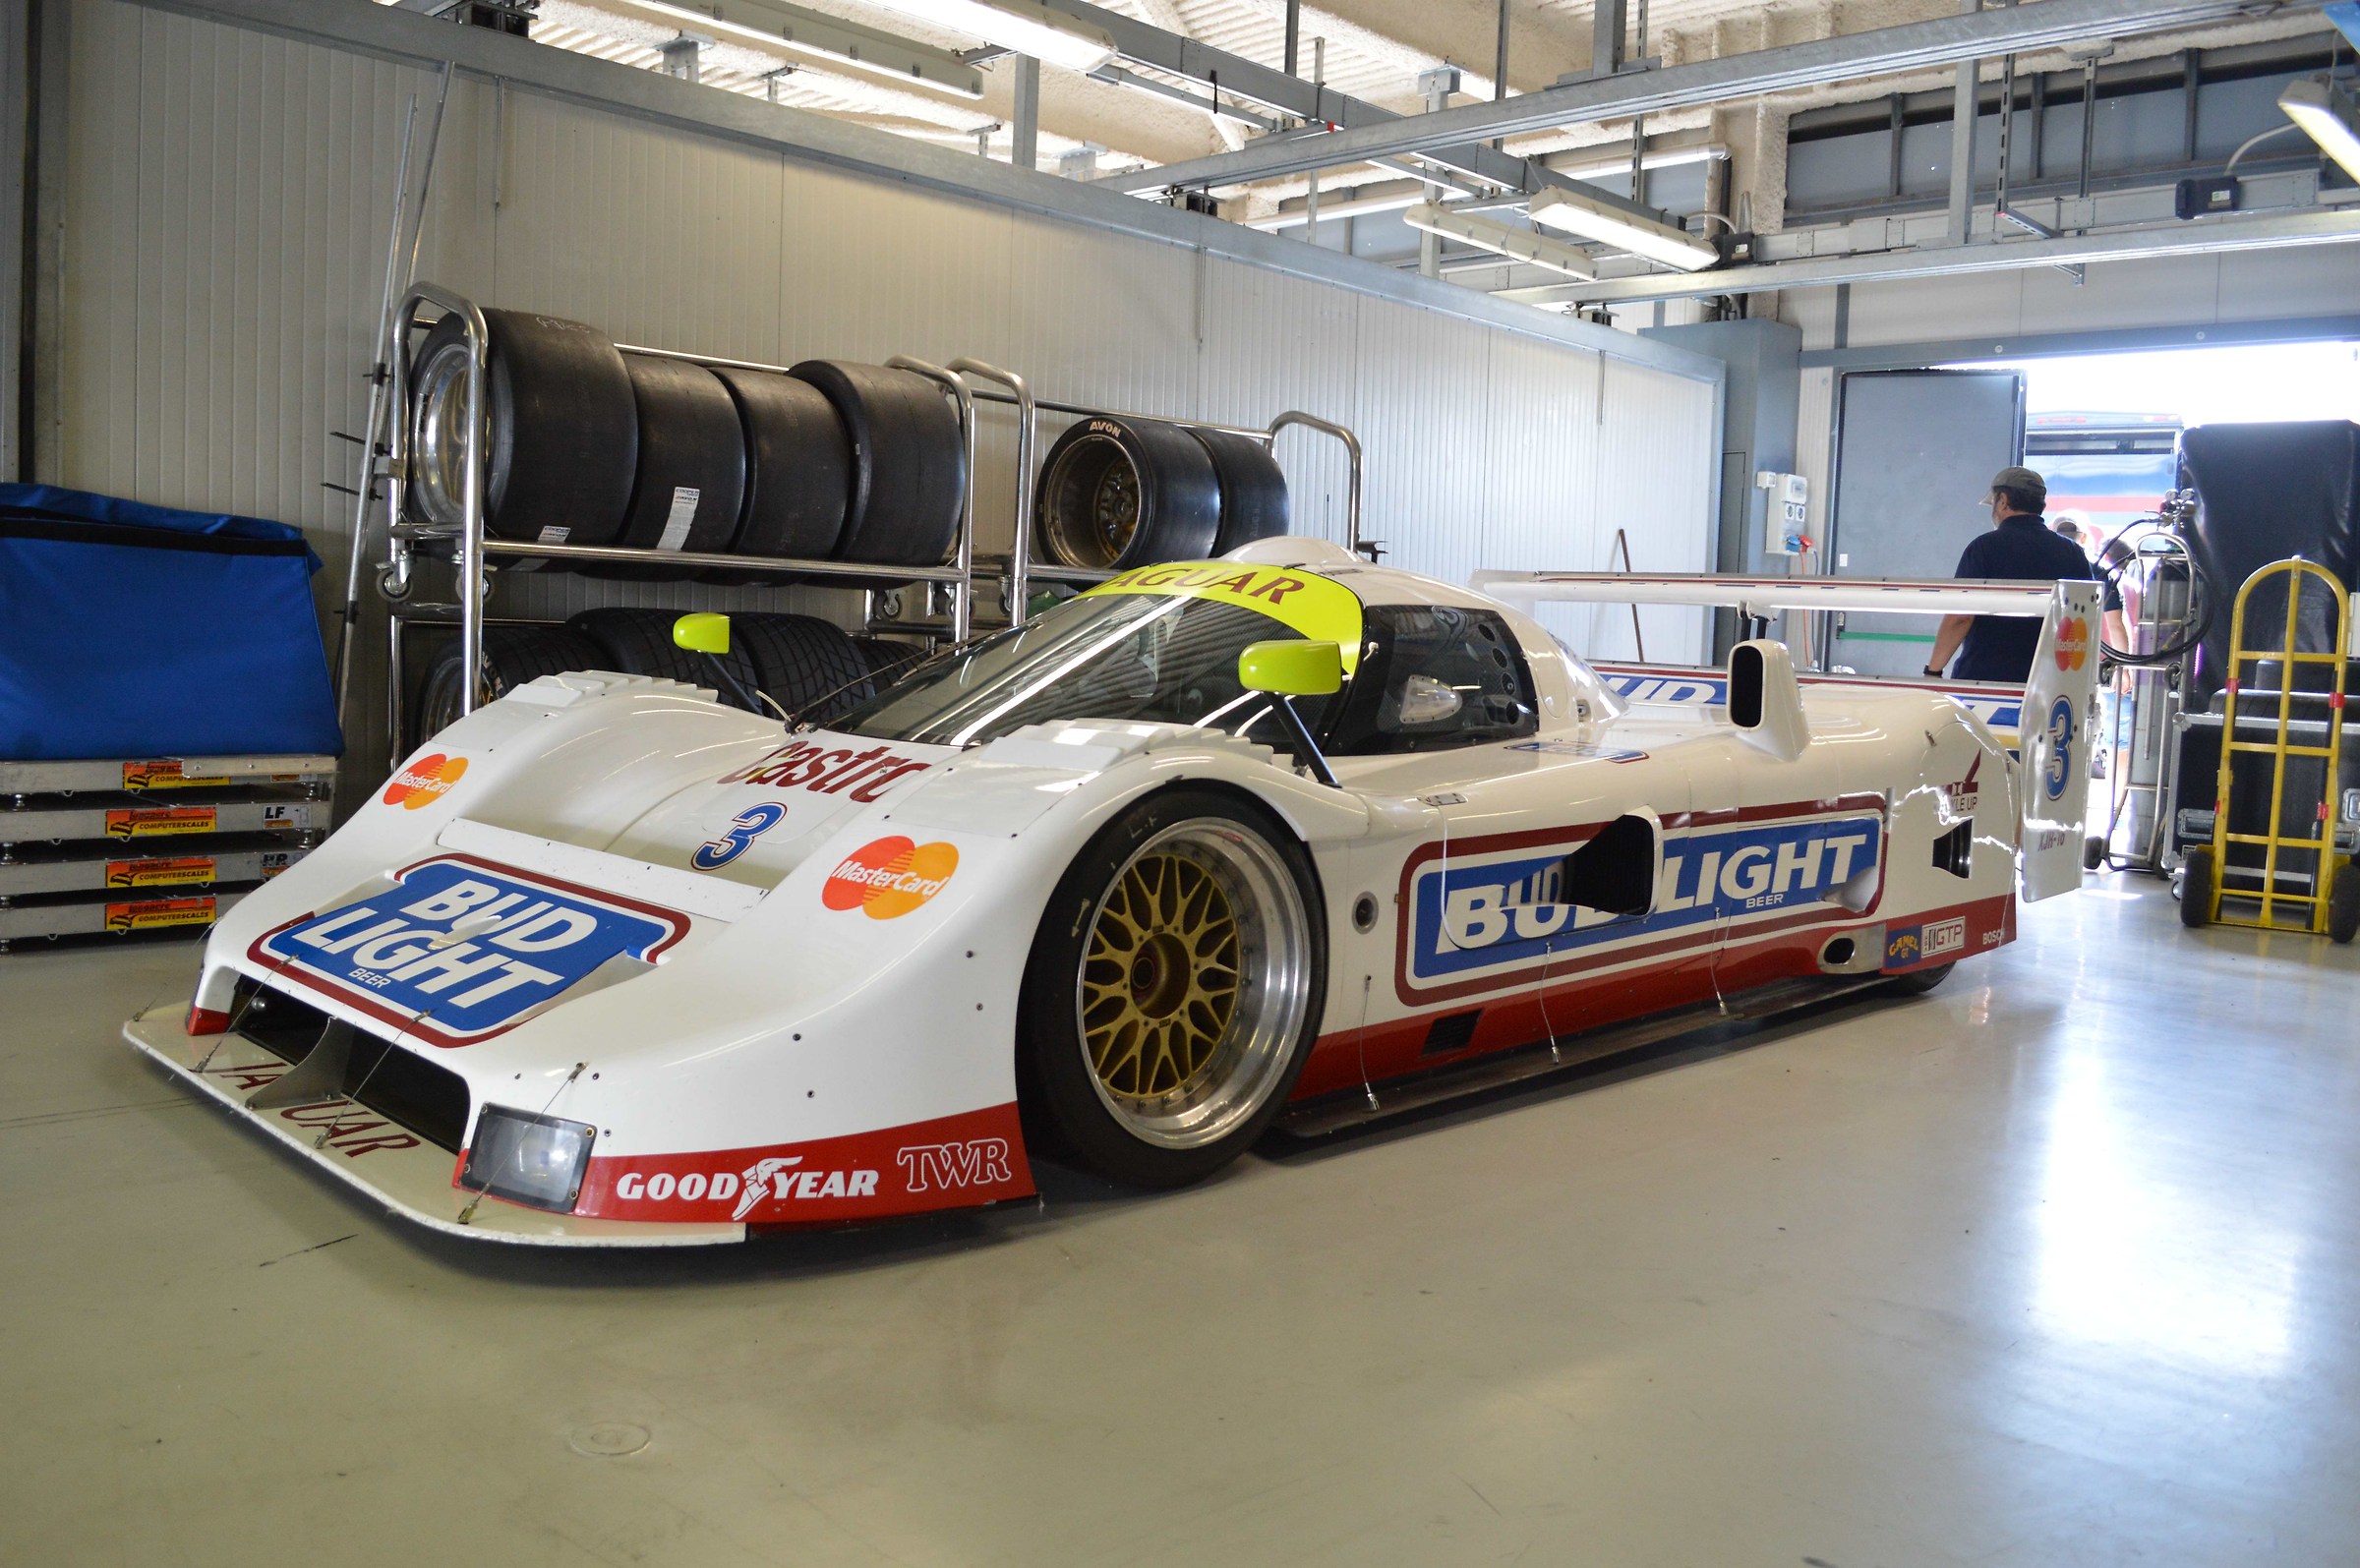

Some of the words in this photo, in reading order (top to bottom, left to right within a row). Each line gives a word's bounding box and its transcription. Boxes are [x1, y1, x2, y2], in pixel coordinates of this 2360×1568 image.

[1089, 420, 1122, 438] AVON
[1111, 567, 1306, 606] AGUAR
[1606, 676, 1716, 705] UD
[2044, 694, 2073, 801] 3
[393, 771, 457, 793] MasterCard
[717, 740, 932, 803] Castro
[265, 806, 285, 820] LF
[1967, 796, 1977, 811] UP
[691, 801, 788, 872] 3
[139, 869, 209, 881] COMPUTERSCALES
[835, 860, 949, 896] MasterCard
[1656, 835, 1867, 913] LIGHT
[399, 879, 597, 953] BUD
[1745, 893, 1784, 909] BEER
[1889, 935, 1919, 957] CAMEL
[1936, 924, 1963, 946] GTP
[292, 906, 564, 1009] LIGHT
[347, 967, 393, 989] BEER
[187, 1062, 421, 1158] JAUAR
[896, 1137, 1012, 1192] TWR
